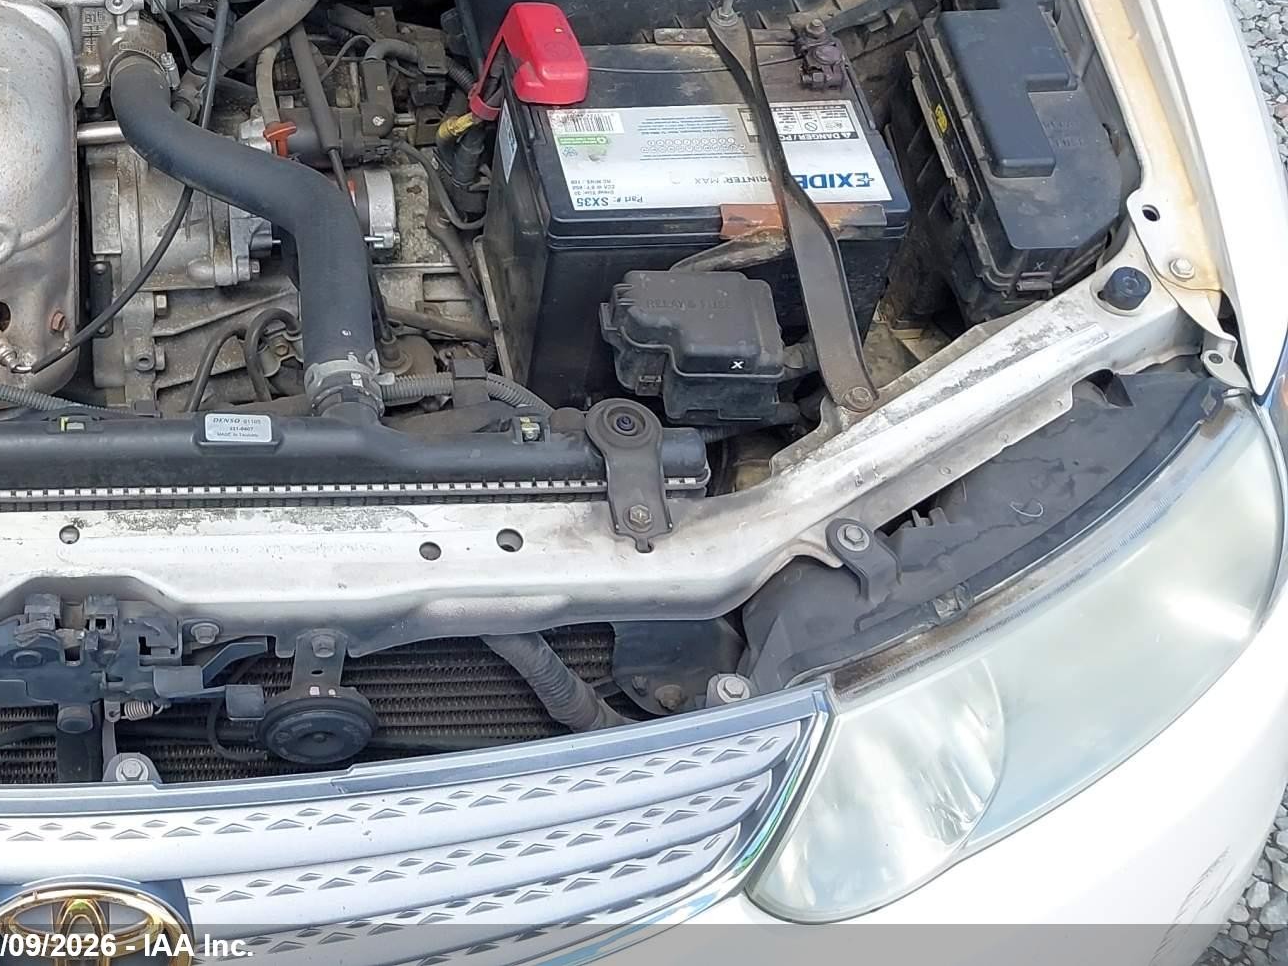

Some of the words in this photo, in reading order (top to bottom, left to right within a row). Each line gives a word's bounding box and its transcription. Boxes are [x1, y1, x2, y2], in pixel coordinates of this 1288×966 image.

[793, 172, 875, 189] EXIDE
[576, 196, 609, 207] SX35
[624, 195, 643, 203] Part
